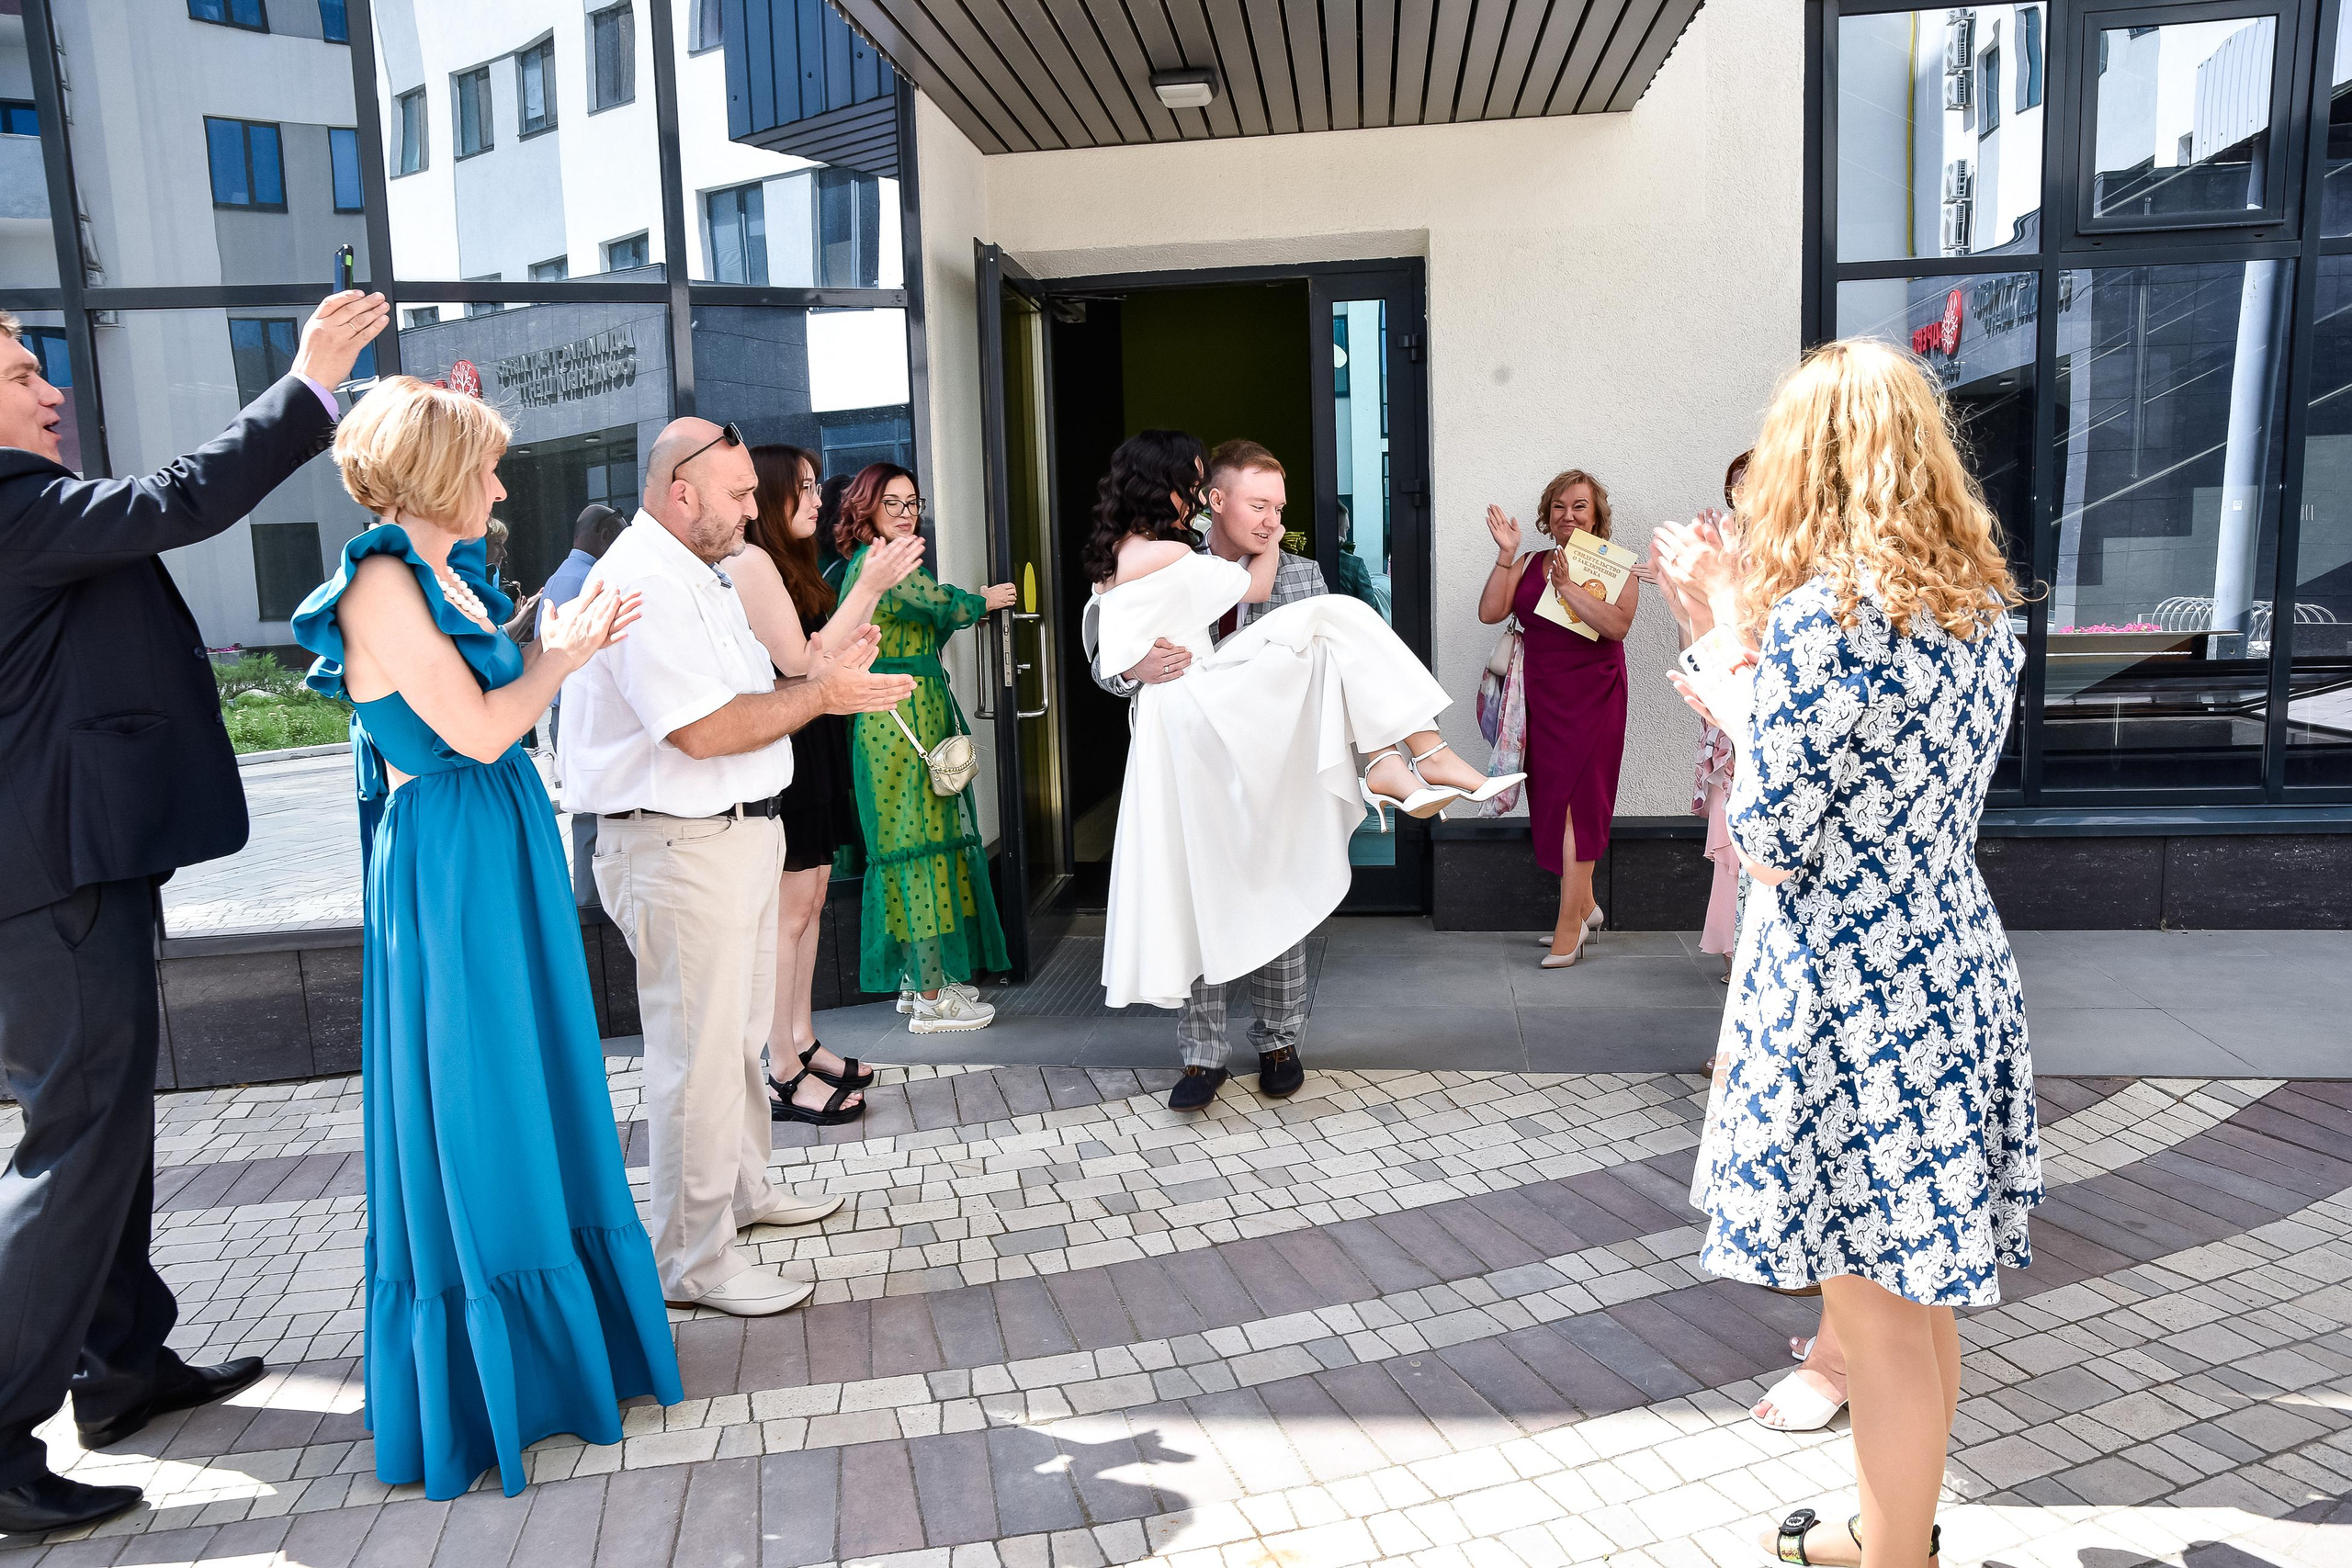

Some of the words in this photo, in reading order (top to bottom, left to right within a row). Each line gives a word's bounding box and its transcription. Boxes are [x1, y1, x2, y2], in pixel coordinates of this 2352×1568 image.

[1573, 550, 1621, 574] СВИДЕТЕЛЬСТВО
[1577, 558, 1617, 579] ЗАКЛЮЧЕНИИ
[1583, 566, 1600, 578] БРАКА
